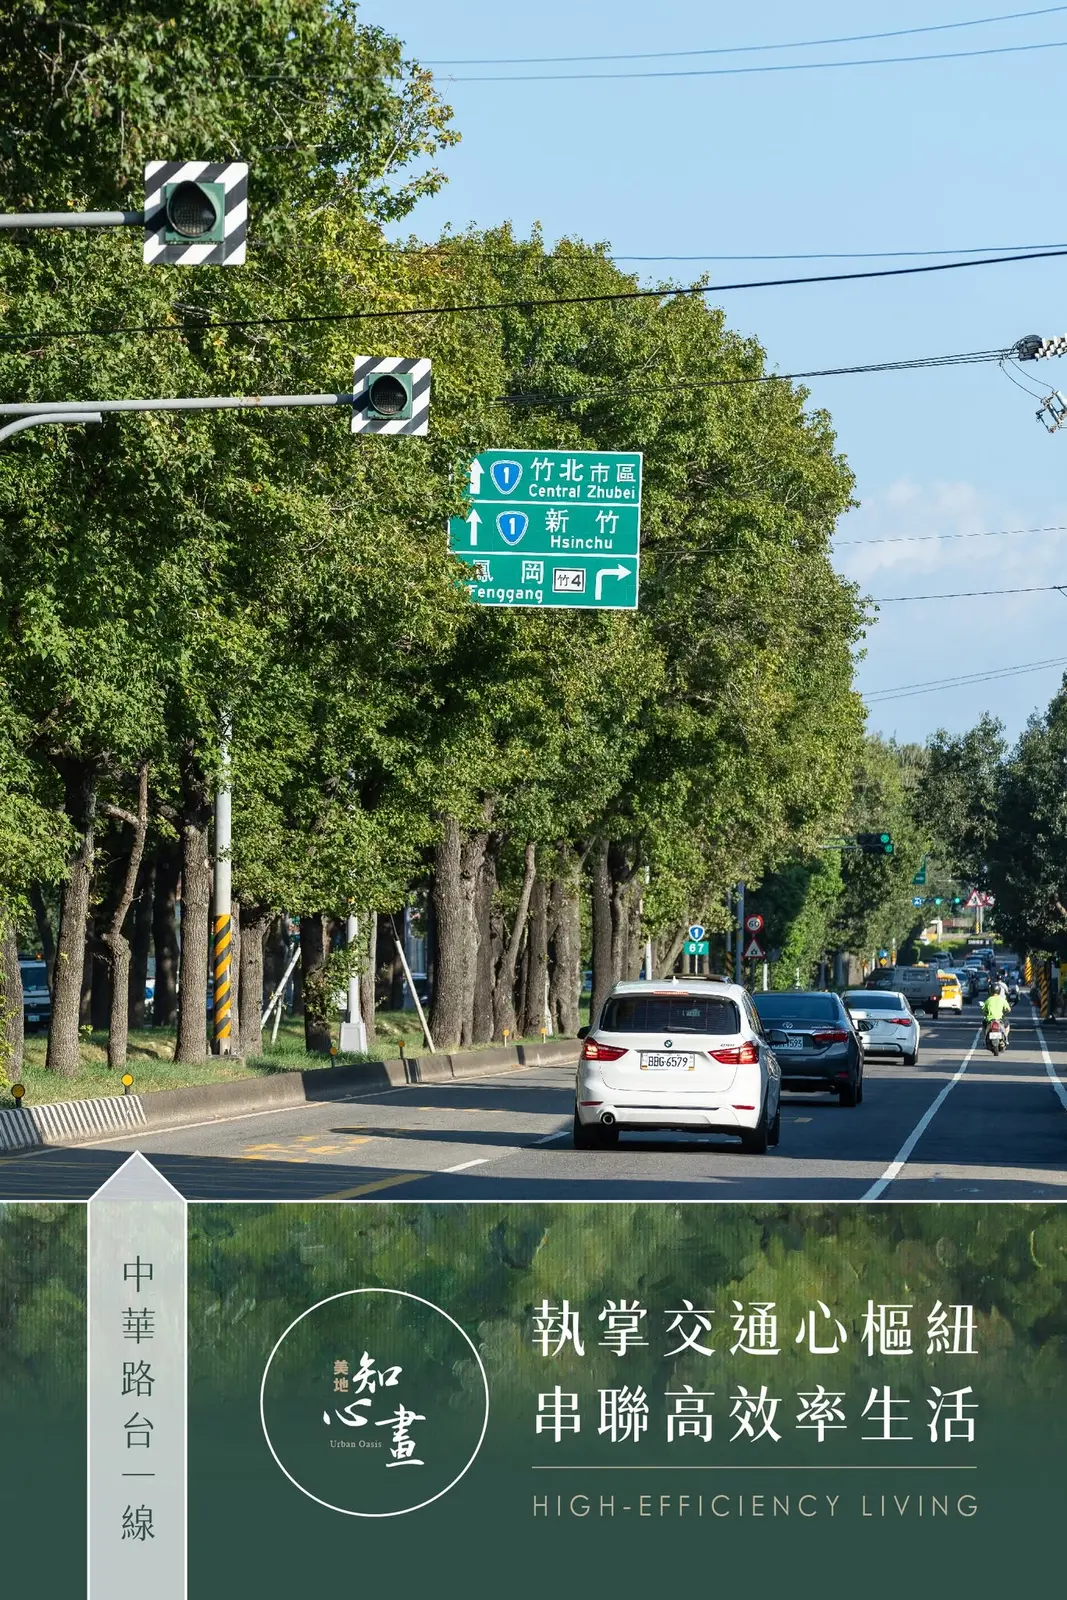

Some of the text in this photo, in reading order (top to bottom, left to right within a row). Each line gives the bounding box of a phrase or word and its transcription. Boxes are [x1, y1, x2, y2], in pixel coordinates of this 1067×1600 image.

[502, 467, 509, 484] 1
[529, 457, 636, 483] 竹北市區
[528, 485, 636, 499] Central Zhubei
[510, 517, 516, 535] 1
[545, 508, 620, 534] 新竹
[550, 535, 613, 549] Hsinchu
[694, 928, 699, 938] 1
[689, 943, 704, 953] 67
[648, 1056, 688, 1067] BBG-6579
